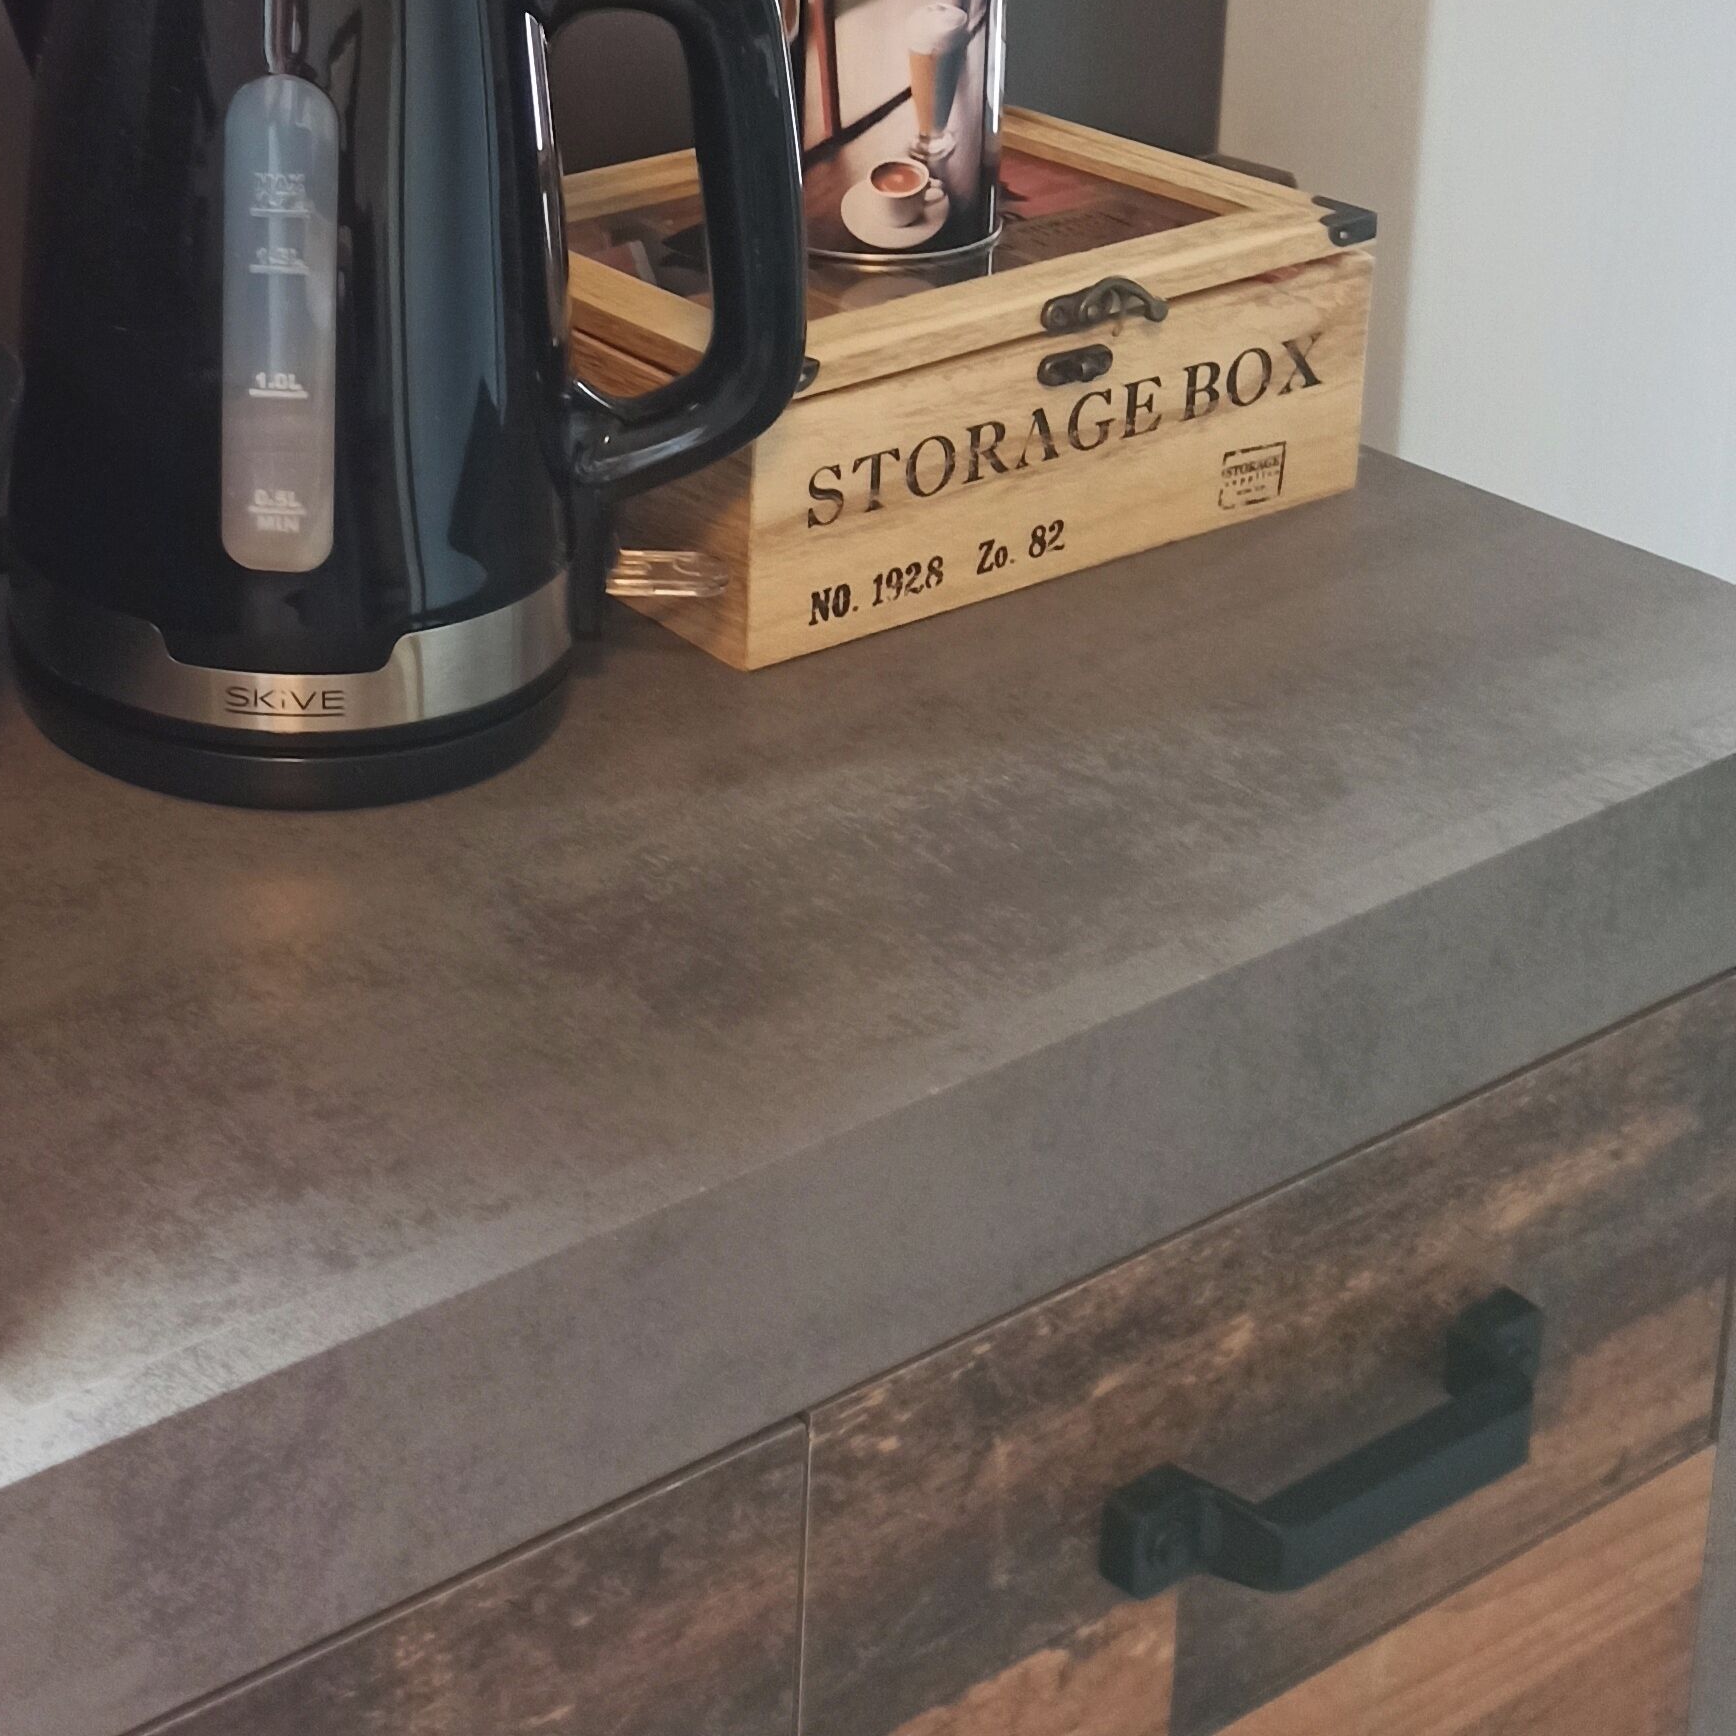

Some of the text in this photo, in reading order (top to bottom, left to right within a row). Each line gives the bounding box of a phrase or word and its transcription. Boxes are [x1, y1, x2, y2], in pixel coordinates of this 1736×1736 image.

[256, 372, 303, 390] 1.0L
[807, 332, 1324, 529] STORAGE BOX
[257, 515, 299, 533] MIN
[808, 583, 859, 626] NO.
[872, 555, 944, 607] 1928
[1028, 519, 1066, 560] 82
